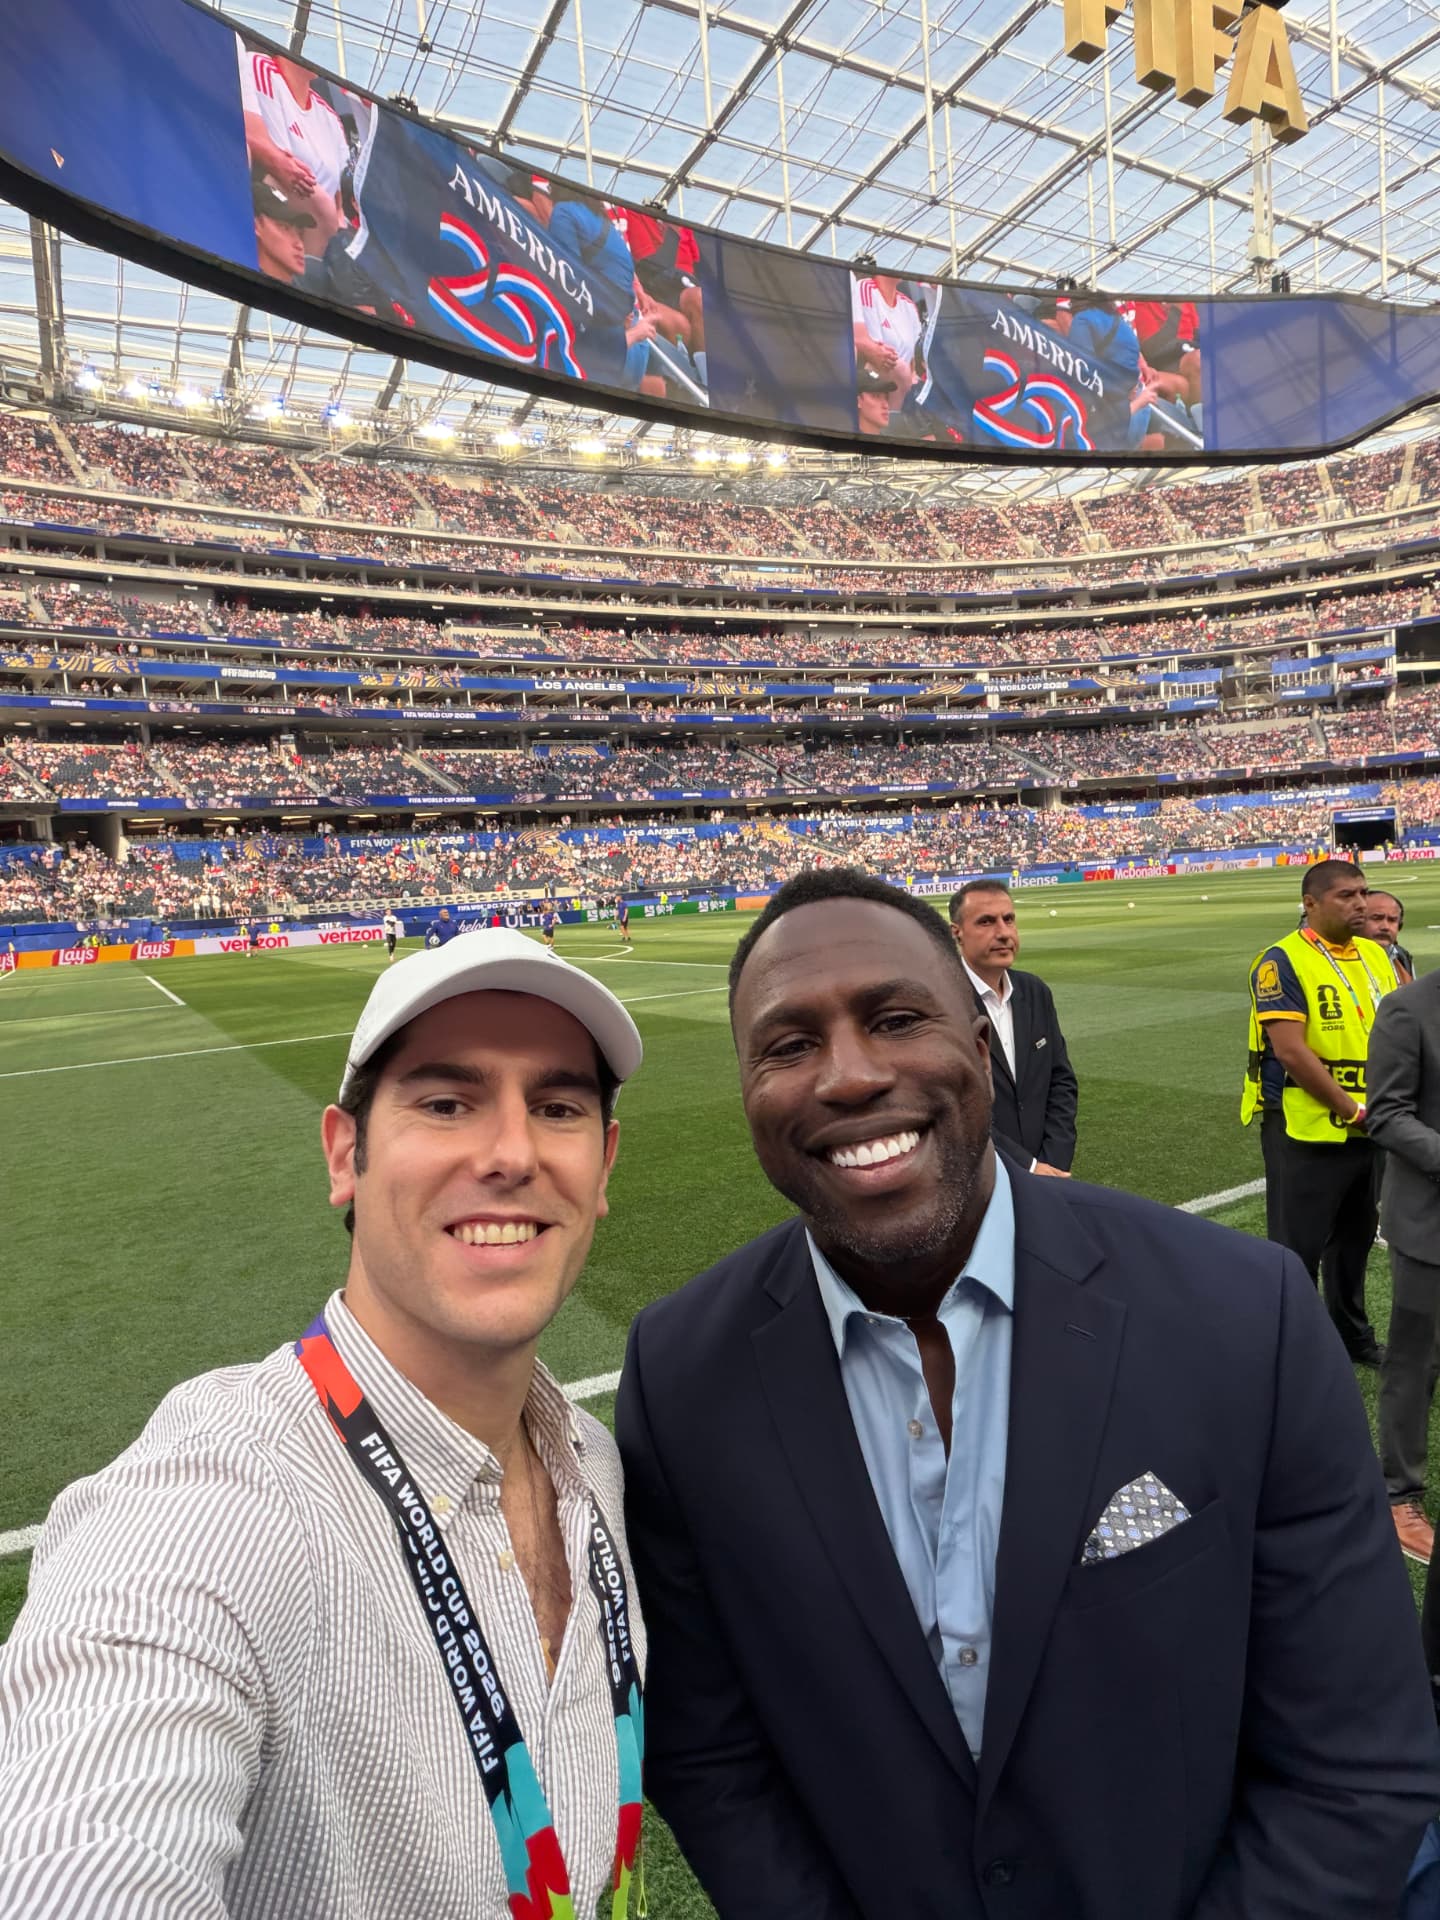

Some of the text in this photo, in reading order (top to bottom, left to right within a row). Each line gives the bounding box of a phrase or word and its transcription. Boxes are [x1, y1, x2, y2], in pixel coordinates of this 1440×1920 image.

[448, 163, 593, 316] AMERICA
[990, 308, 1105, 398] AMERICA
[534, 681, 626, 692] LOS ANGELES
[984, 685, 999, 693] FIFA
[1000, 684, 1027, 692] WORLD
[623, 829, 645, 837] LOS
[350, 839, 373, 848] FIFA
[1387, 849, 1435, 860] vezon
[1113, 865, 1169, 880] McDonald's
[1008, 875, 1059, 888] Hisense
[219, 935, 289, 952] verzon
[318, 927, 383, 944] verizon
[58, 947, 95, 965] Lay's
[136, 941, 171, 959] Lay's
[360, 1432, 402, 1487] FIFA
[397, 1482, 447, 1576] WORLD
[441, 1577, 470, 1627] CUP
[462, 1629, 505, 1718] 2026
[593, 1527, 624, 1612] WORLD
[616, 1611, 631, 1662] FIFA
[436, 1614, 499, 1774] FIFA WORLD
